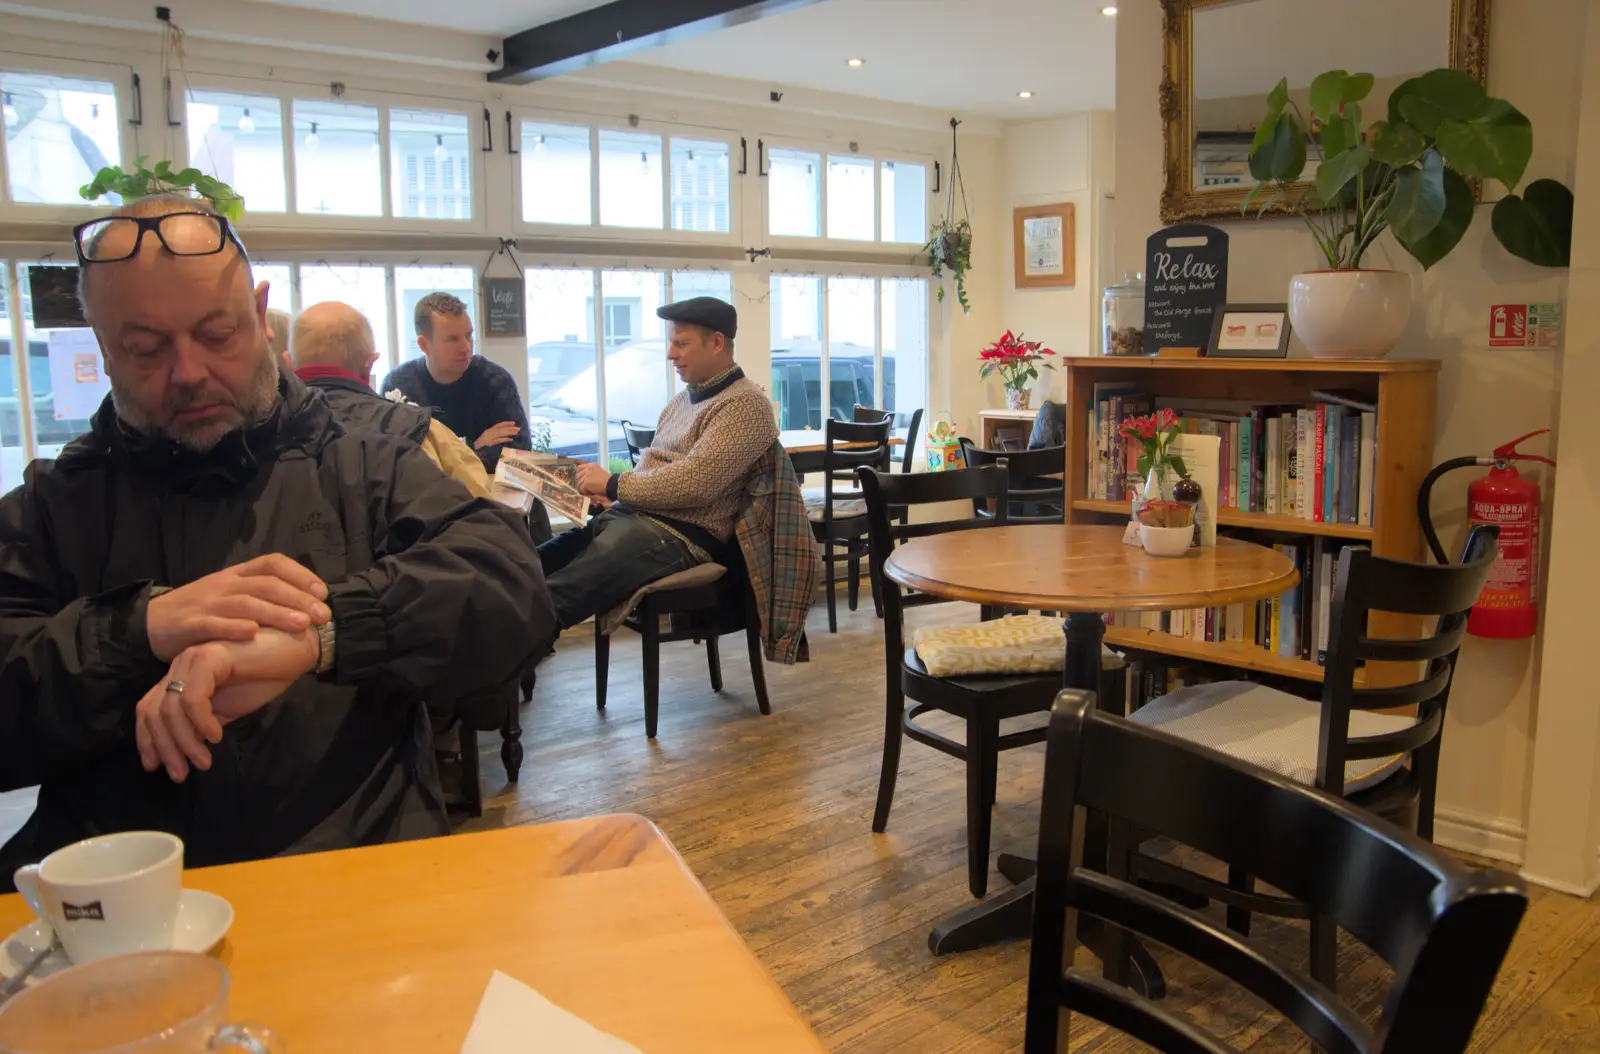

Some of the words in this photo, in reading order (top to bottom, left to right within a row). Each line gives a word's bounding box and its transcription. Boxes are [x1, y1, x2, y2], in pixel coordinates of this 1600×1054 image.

[1154, 252, 1219, 280] Relax
[1153, 282, 1167, 292] and
[1169, 283, 1186, 294] enjoy
[1241, 435, 1249, 463] TIME
[1240, 472, 1249, 495] TEA
[1475, 503, 1528, 514] AQUA-SPRAY
